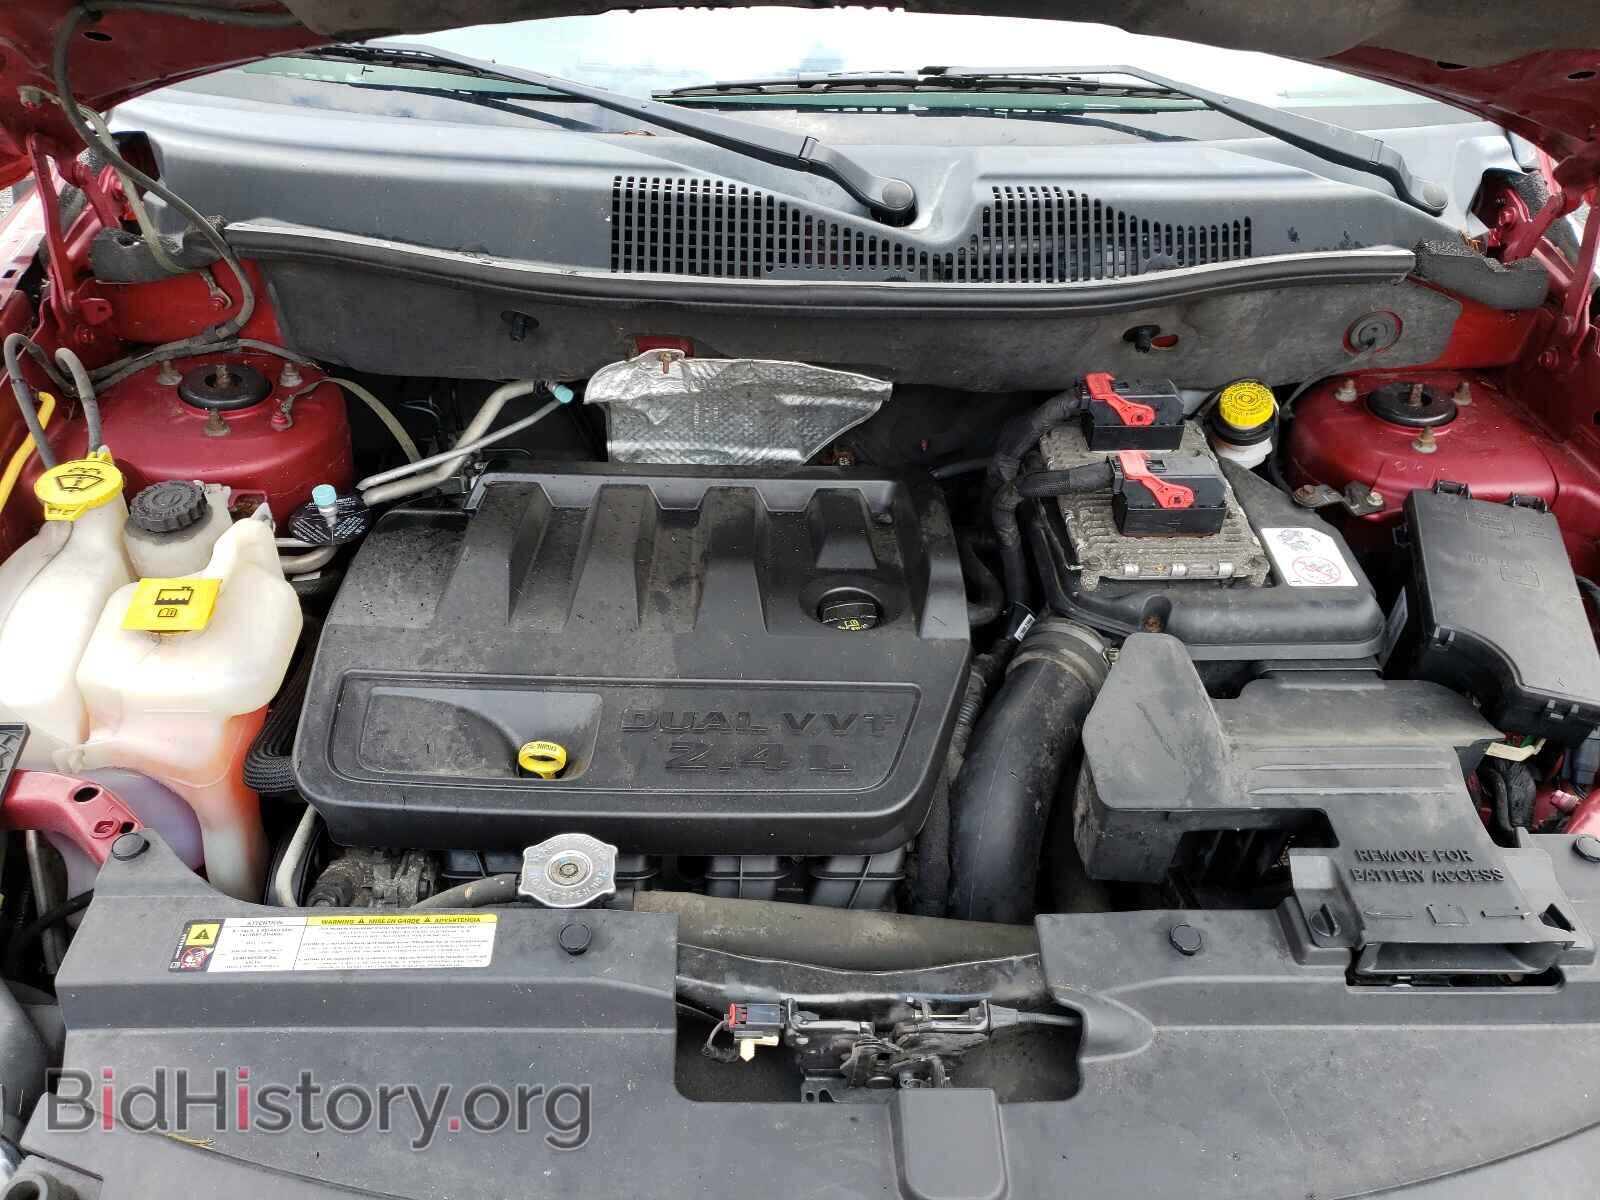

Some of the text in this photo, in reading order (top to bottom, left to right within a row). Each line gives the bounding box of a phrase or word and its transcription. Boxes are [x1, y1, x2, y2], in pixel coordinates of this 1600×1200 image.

[621, 707, 897, 735] DUAL VVT
[1354, 849, 1475, 863] REMOVE FOR
[1349, 867, 1505, 883] BATTERY ACCESS
